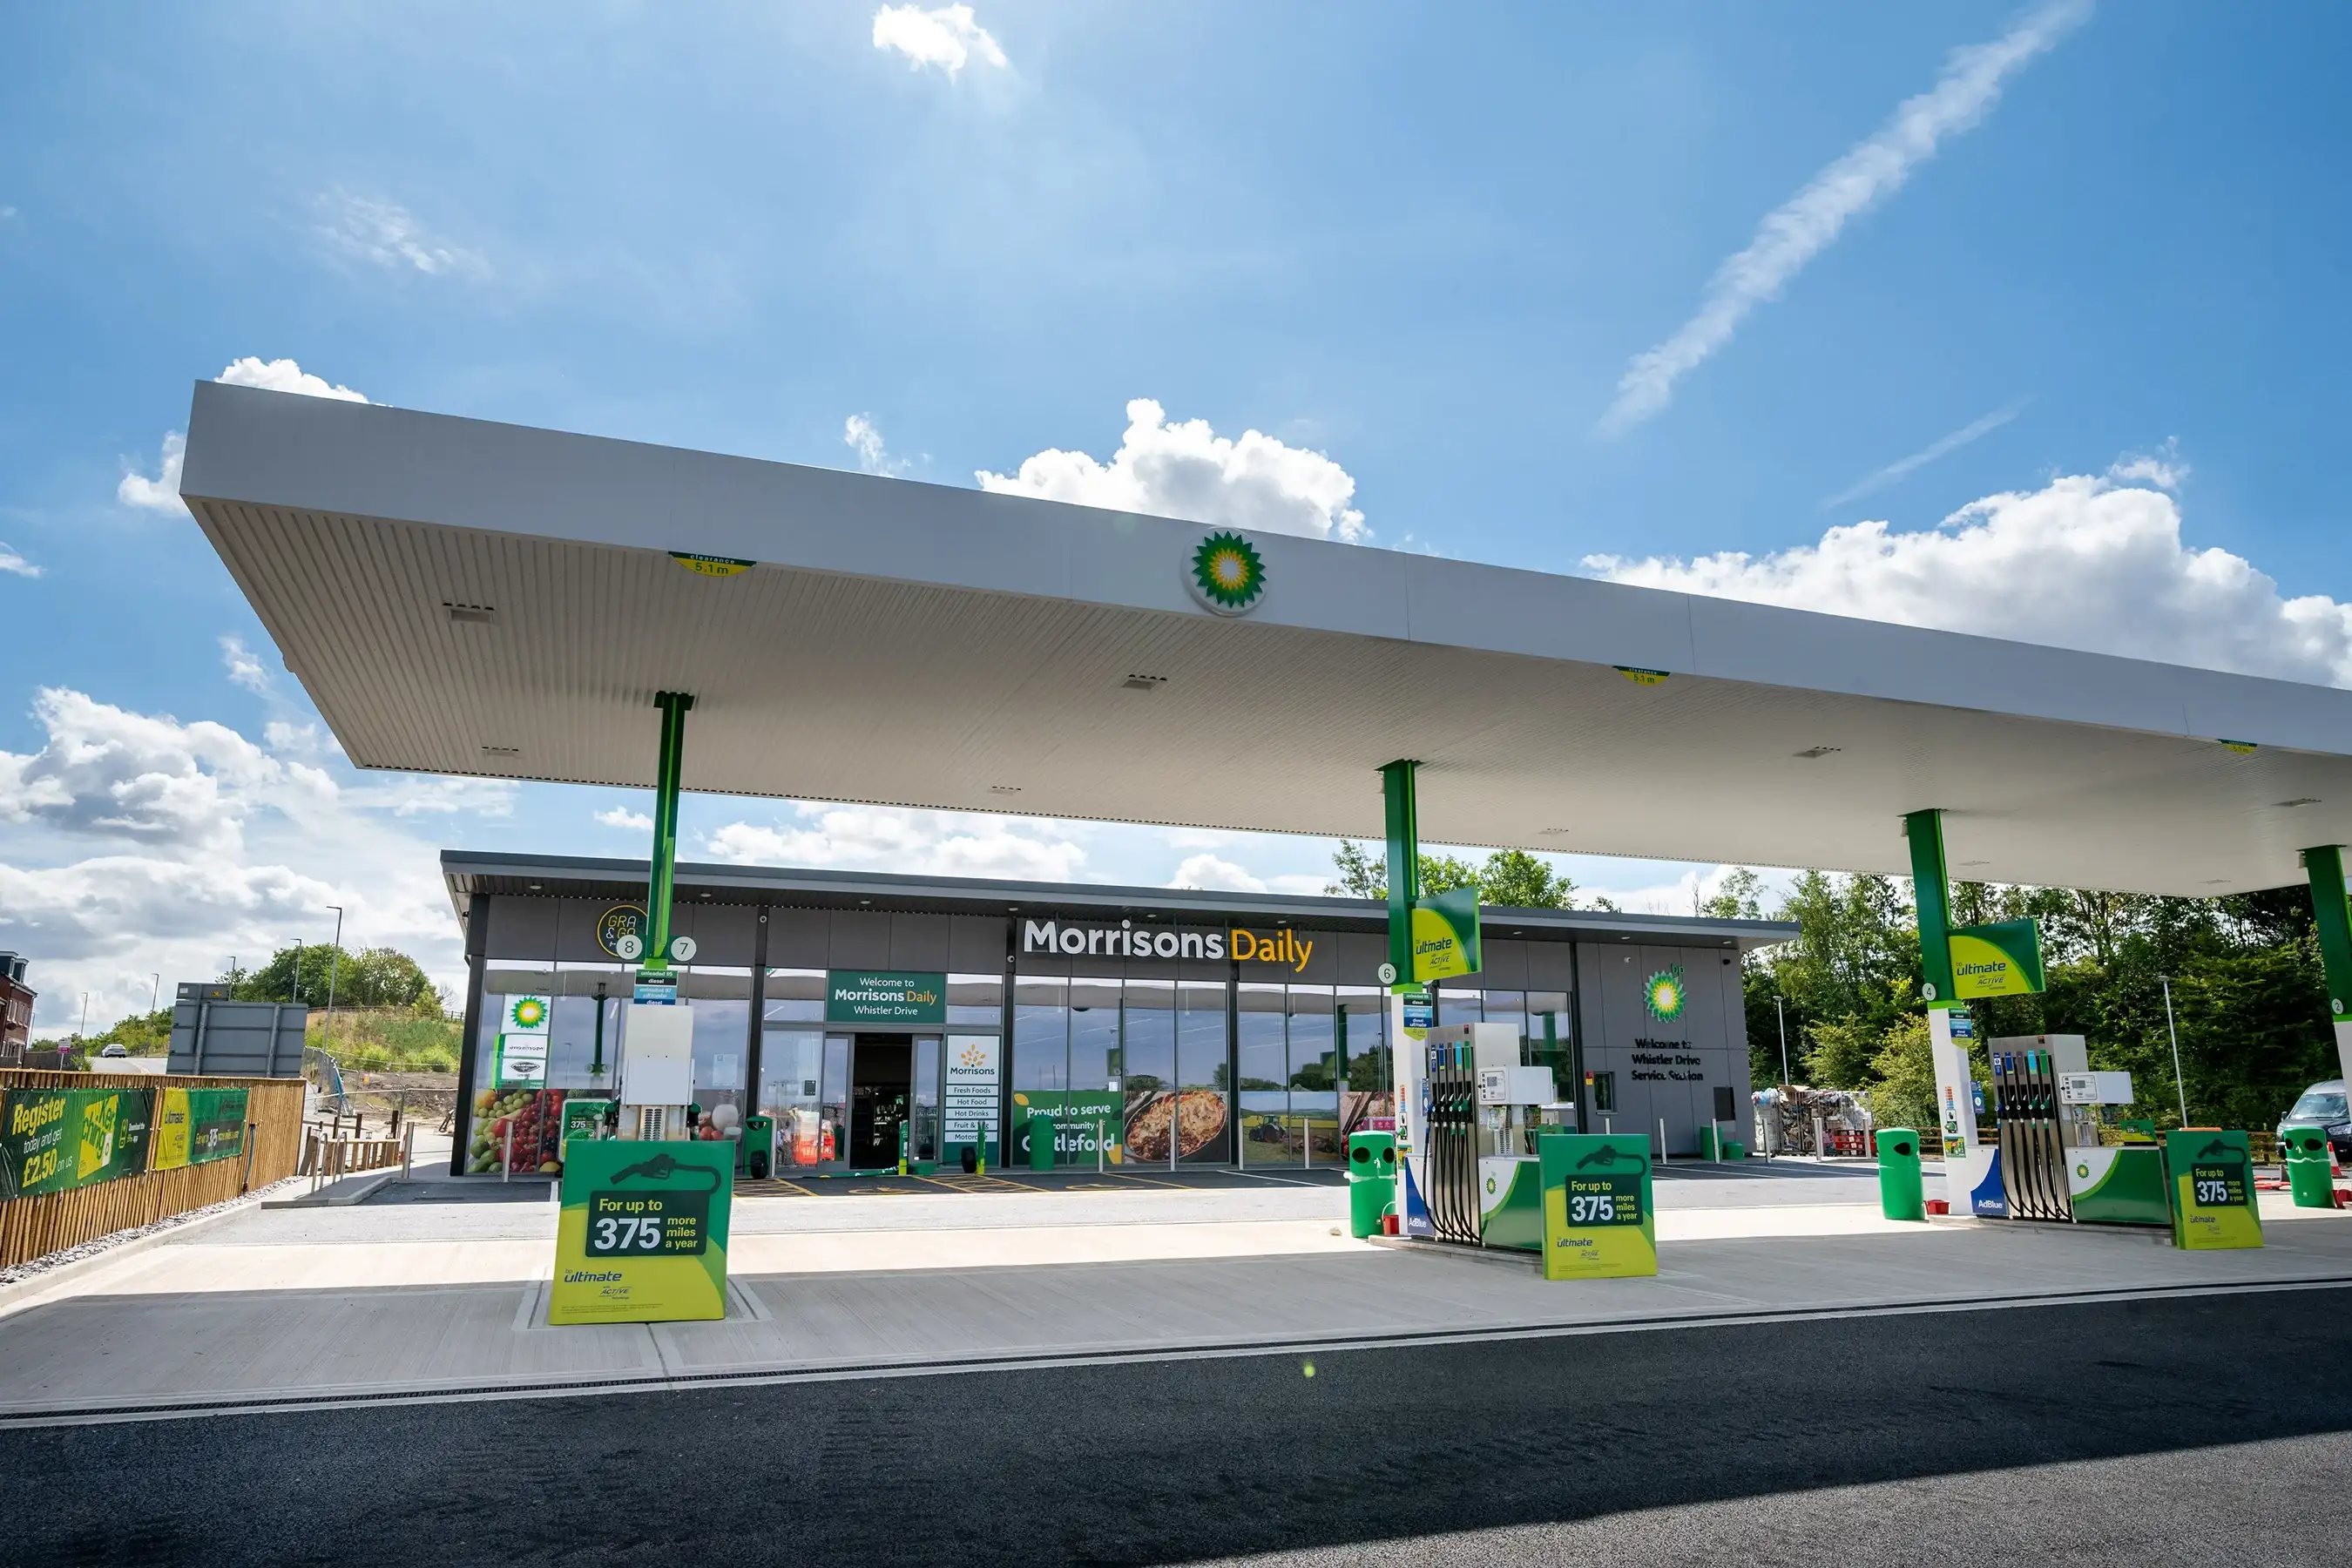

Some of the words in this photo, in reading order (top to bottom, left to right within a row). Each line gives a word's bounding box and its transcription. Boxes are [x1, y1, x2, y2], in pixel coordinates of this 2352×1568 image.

[690, 554, 735, 564] clearance
[695, 562, 713, 572] 5.1
[716, 566, 728, 575] m
[1633, 673, 1645, 682] 5.1
[625, 941, 634, 954] 8
[679, 943, 689, 955] 7
[1024, 919, 1224, 959] Morrisons
[1230, 928, 1313, 973] Daily
[1416, 937, 1453, 955] ultimate
[1383, 968, 1391, 979] 6
[1670, 963, 1684, 977] bp
[1957, 961, 2006, 976] ultimate
[859, 977, 902, 987] Welcome
[835, 988, 904, 1002] Morrisons
[906, 990, 937, 1006] Daily
[1926, 987, 1932, 996] 4
[854, 1005, 892, 1015] Whistler
[894, 1006, 918, 1016] Drive
[2335, 1002, 2341, 1010] 2
[1635, 1038, 1680, 1049] Welcome
[1632, 1053, 1673, 1065] Whistler
[1675, 1055, 1700, 1065] Drive
[1632, 1070, 1666, 1081] Service
[12, 1098, 66, 1136] Register
[1027, 1104, 1062, 1119] Proud
[1080, 1105, 1111, 1115] serve
[24, 1132, 40, 1154] today
[41, 1130, 52, 1146] and
[52, 1127, 63, 1146] get
[1022, 1133, 1115, 1152] Ctlefod
[23, 1148, 57, 1187] £2.50
[57, 1159, 65, 1172] on
[65, 1155, 73, 1167] us
[2195, 1168, 2207, 1177] For
[2208, 1169, 2216, 1178] up
[1571, 1180, 1587, 1191] For
[1589, 1183, 1601, 1193] up
[1602, 1181, 1612, 1191] to
[2197, 1180, 2227, 1202] 375
[598, 1198, 623, 1212] For
[625, 1200, 644, 1213] up
[647, 1200, 662, 1211] to
[1571, 1195, 1614, 1221] 375
[1978, 1200, 2004, 1209] AdBlue
[1409, 1217, 1427, 1228] AdBlue
[1623, 1213, 1638, 1221] year
[594, 1218, 661, 1249] 375
[666, 1227, 696, 1237] miles
[675, 1240, 699, 1250] year
[1557, 1237, 1593, 1247] ultimate
[564, 1270, 623, 1283] ultimate
